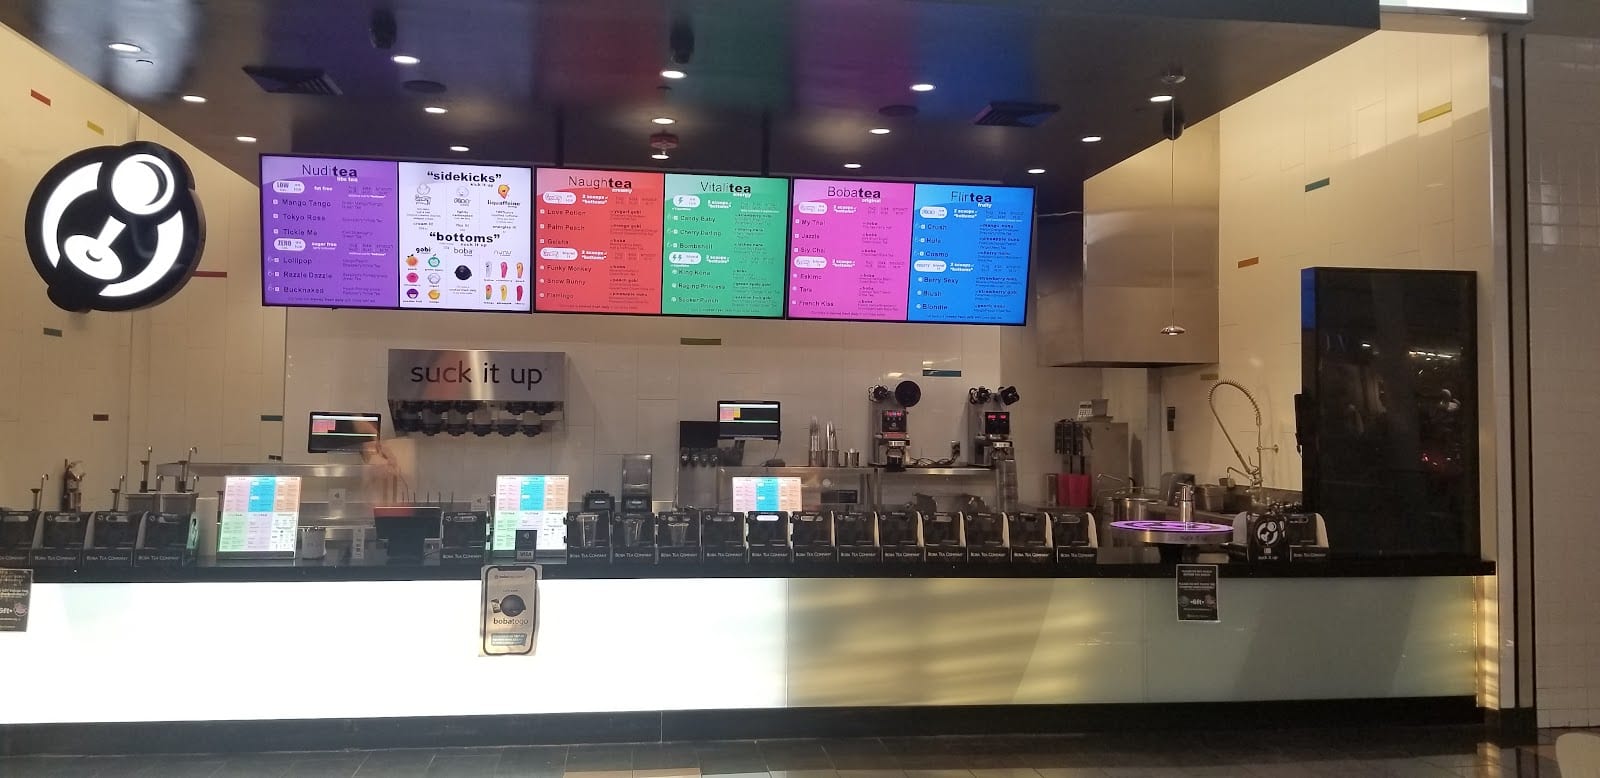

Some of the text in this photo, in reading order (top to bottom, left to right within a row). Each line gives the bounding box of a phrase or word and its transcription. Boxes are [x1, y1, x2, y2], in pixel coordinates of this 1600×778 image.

[302, 164, 358, 177] Nuditea
[569, 176, 632, 189] Naughtea
[701, 181, 751, 193] Vitalitea
[828, 186, 881, 198] Bobatea
[951, 191, 992, 203] Flirtea
[282, 200, 331, 208] Mango Tango
[283, 213, 305, 221] Tokyo
[454, 247, 472, 255] boba
[283, 257, 312, 265] Lollipop
[283, 271, 307, 279] Razzle
[283, 286, 324, 294] Bucknaked
[546, 292, 574, 300] Flamingo
[411, 360, 543, 391] suck it up
